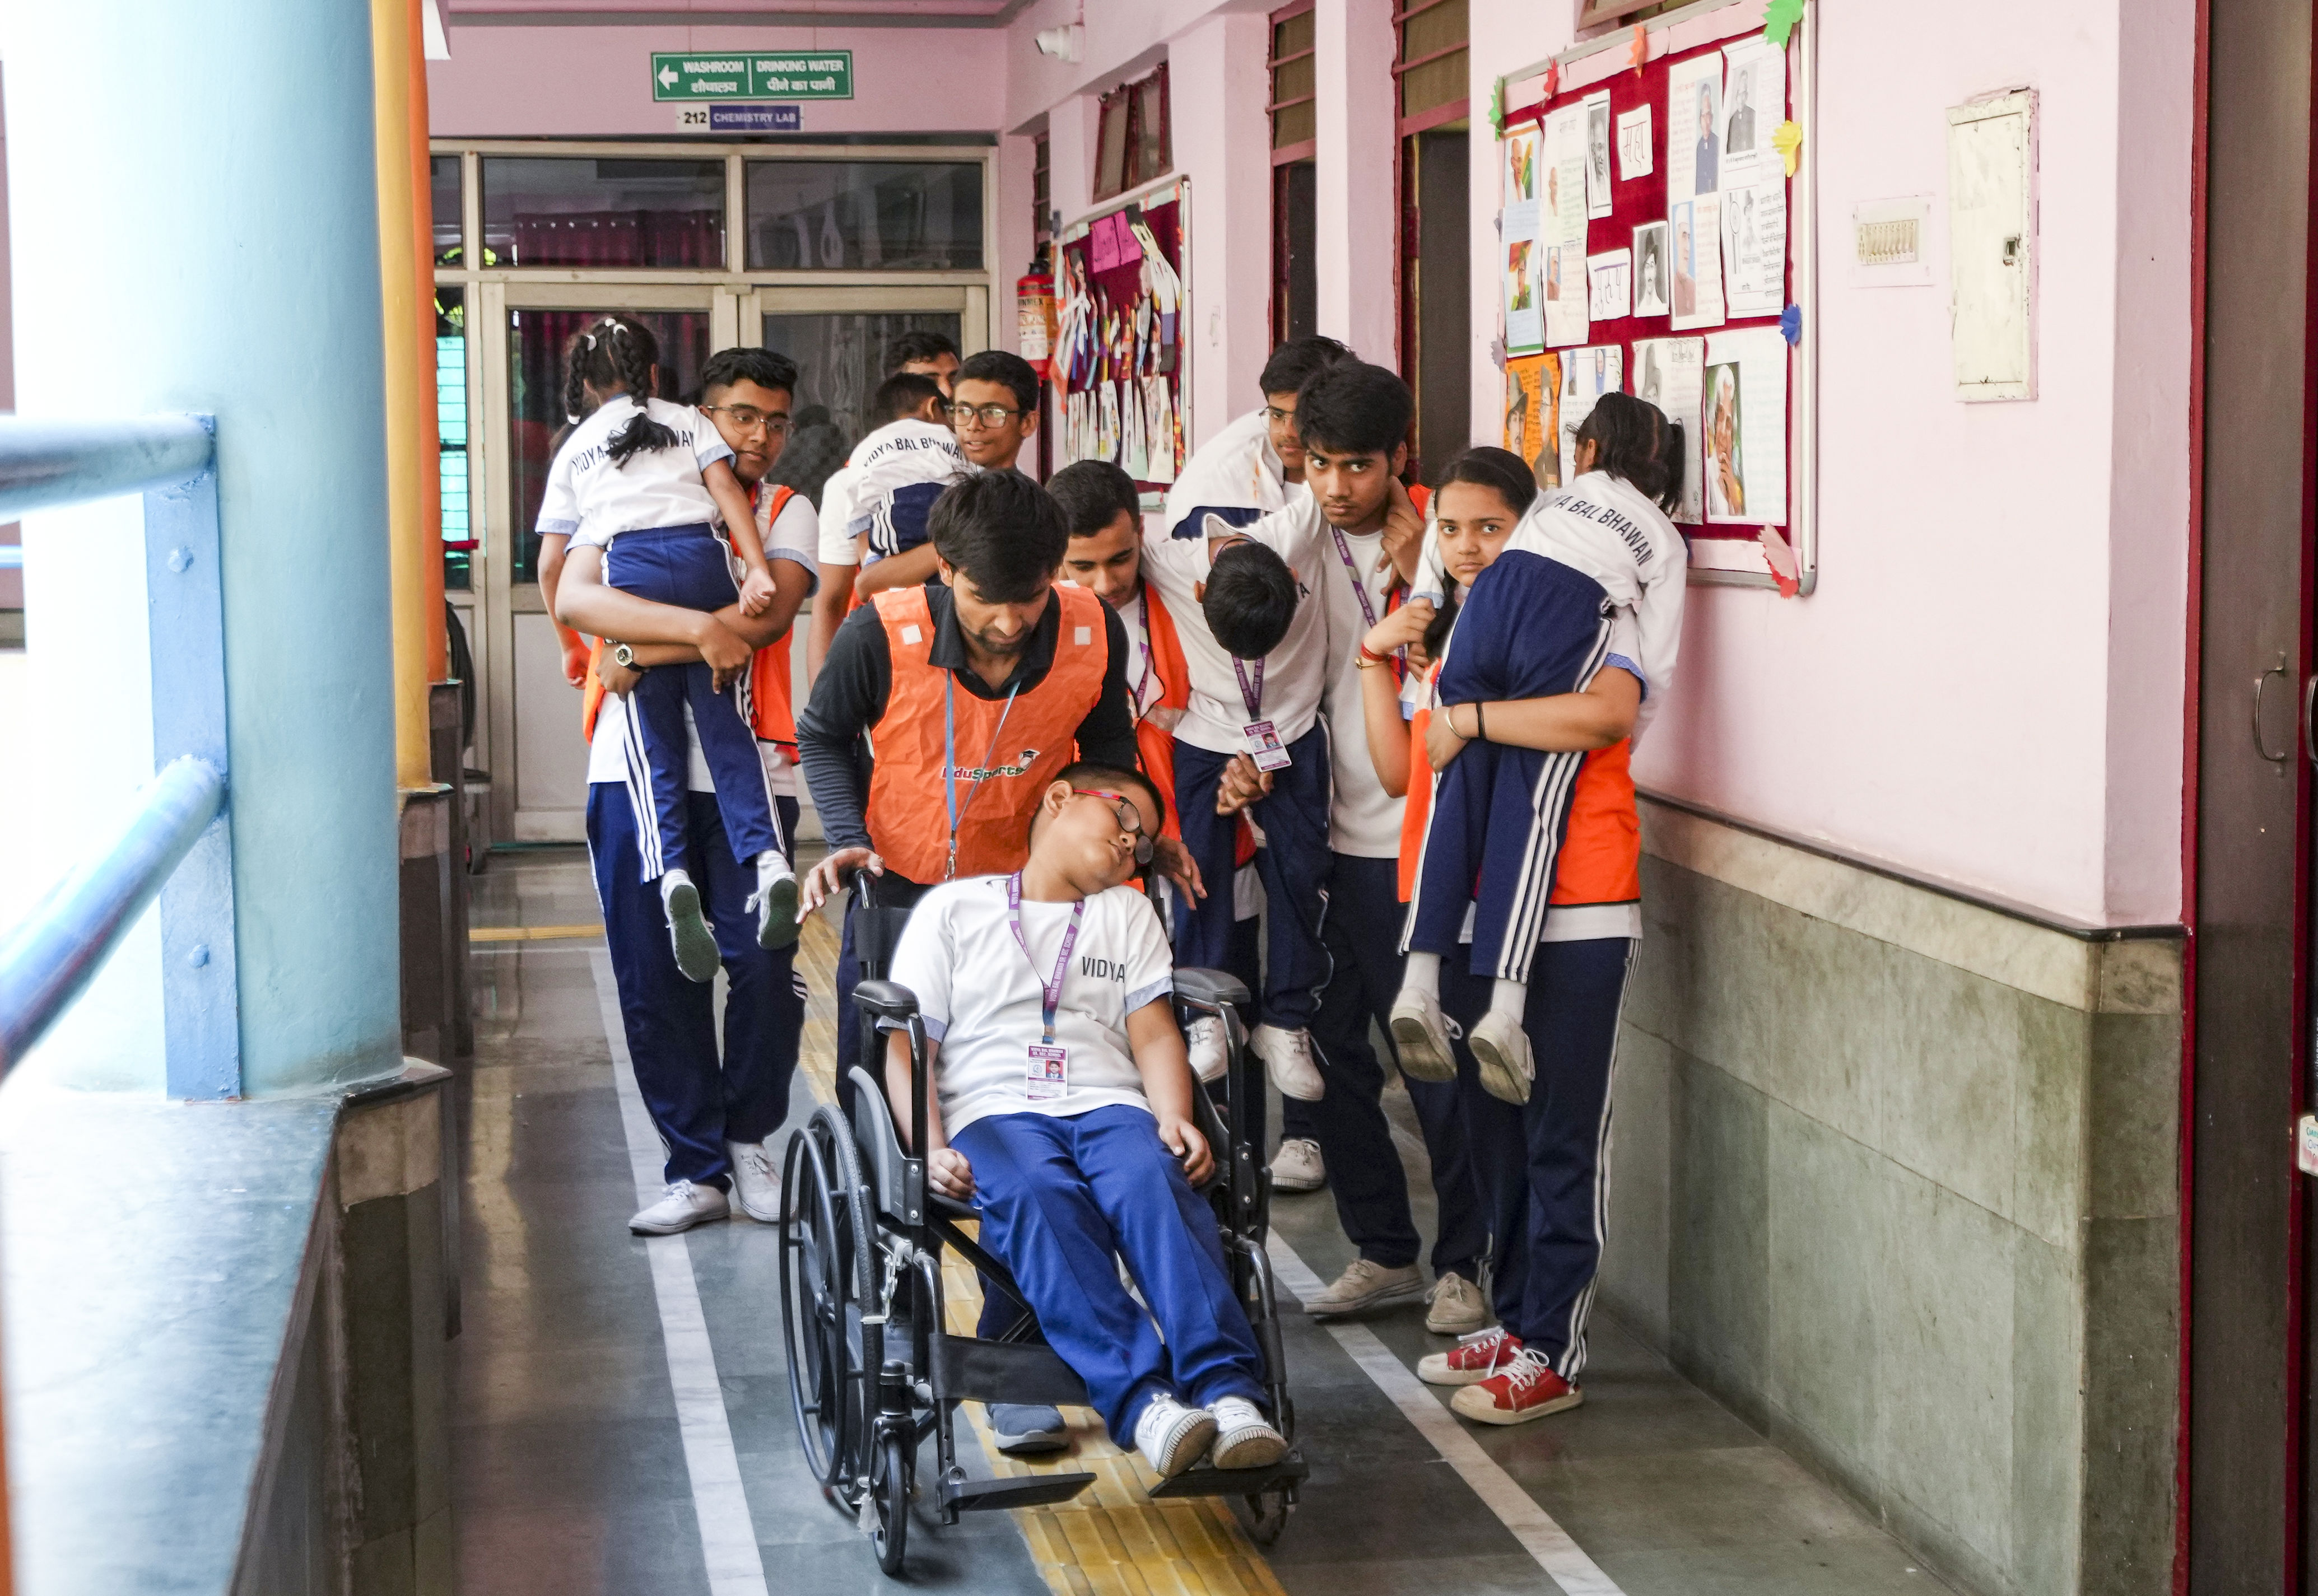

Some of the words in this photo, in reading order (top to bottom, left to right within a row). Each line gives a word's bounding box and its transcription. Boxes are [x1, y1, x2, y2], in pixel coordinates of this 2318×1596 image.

[683, 61, 744, 73] WASHROOM
[756, 60, 807, 72] DRINKING
[808, 59, 844, 72] WATER
[684, 112, 707, 123] 212
[713, 113, 773, 123] CHEMISTRY
[775, 113, 796, 123] LAB
[895, 438, 919, 450] BAL
[1567, 500, 1603, 520] BAL
[1597, 508, 1654, 568] BHAWAN
[1082, 956, 1125, 983] VIDYA
